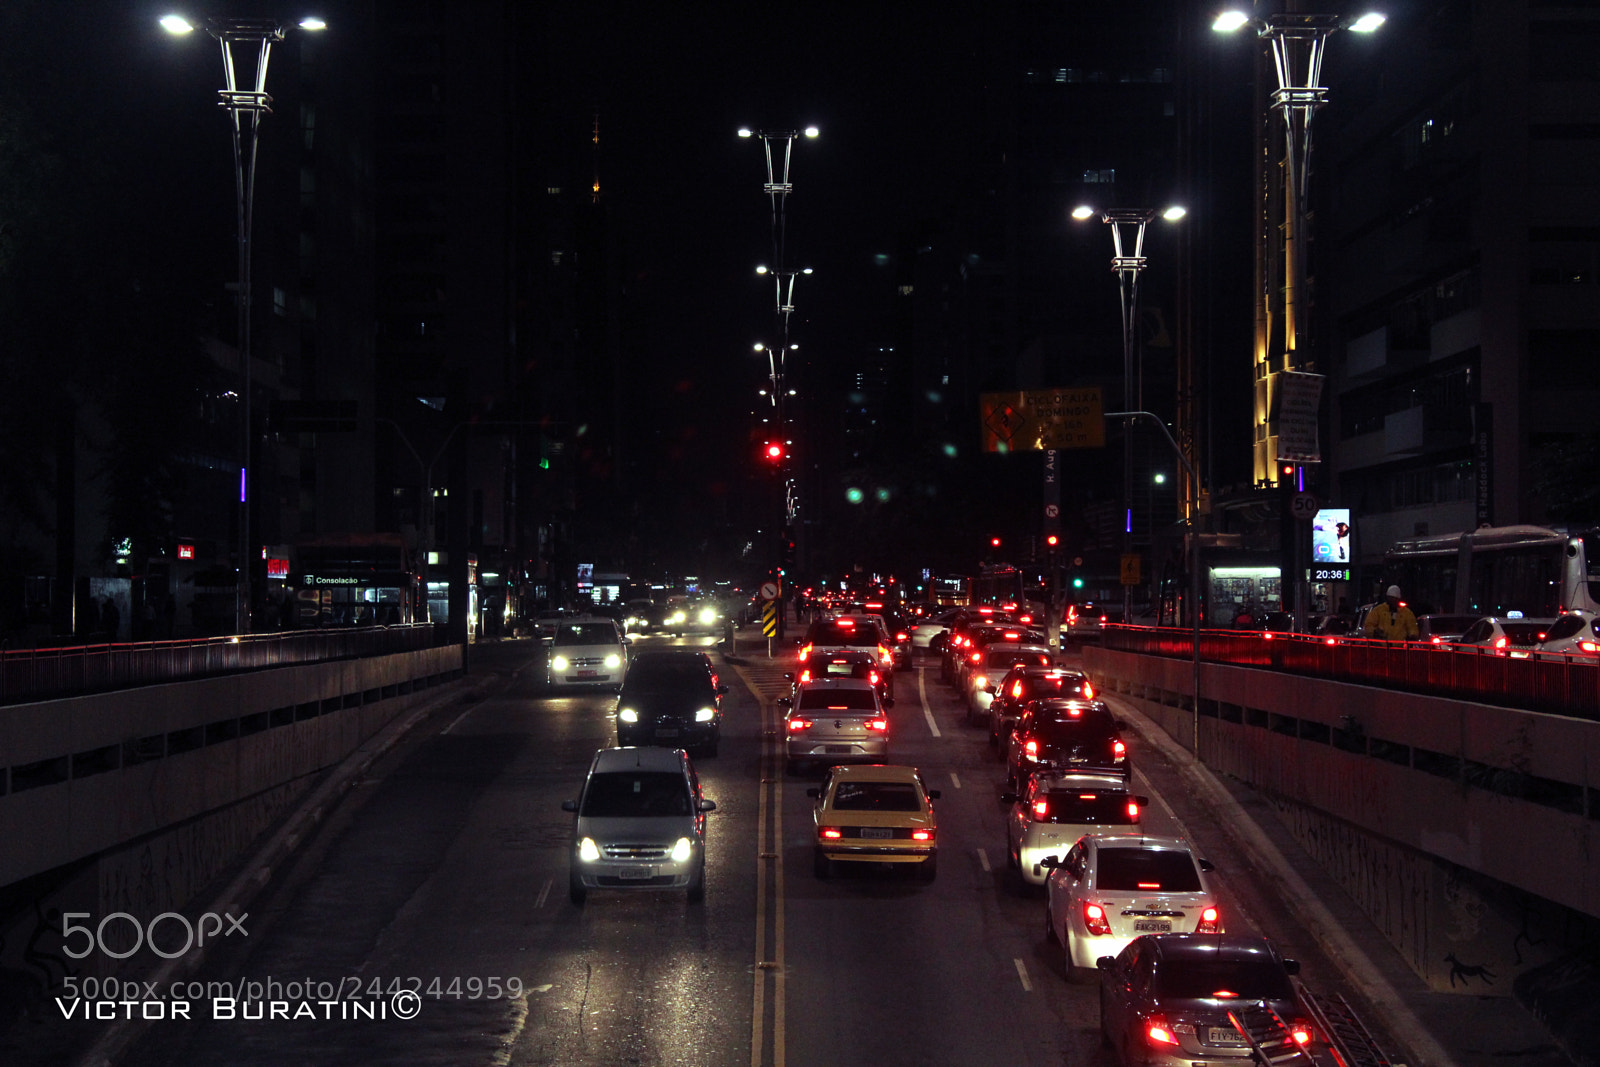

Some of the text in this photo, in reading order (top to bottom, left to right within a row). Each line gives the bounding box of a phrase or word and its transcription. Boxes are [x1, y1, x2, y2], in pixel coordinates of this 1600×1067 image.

[1027, 393, 1098, 405] CICLOFAIXA
[1037, 407, 1090, 417] DOMINGO
[1046, 449, 1056, 470] Aug
[1295, 498, 1315, 511] 50
[1315, 569, 1343, 579] 20:36
